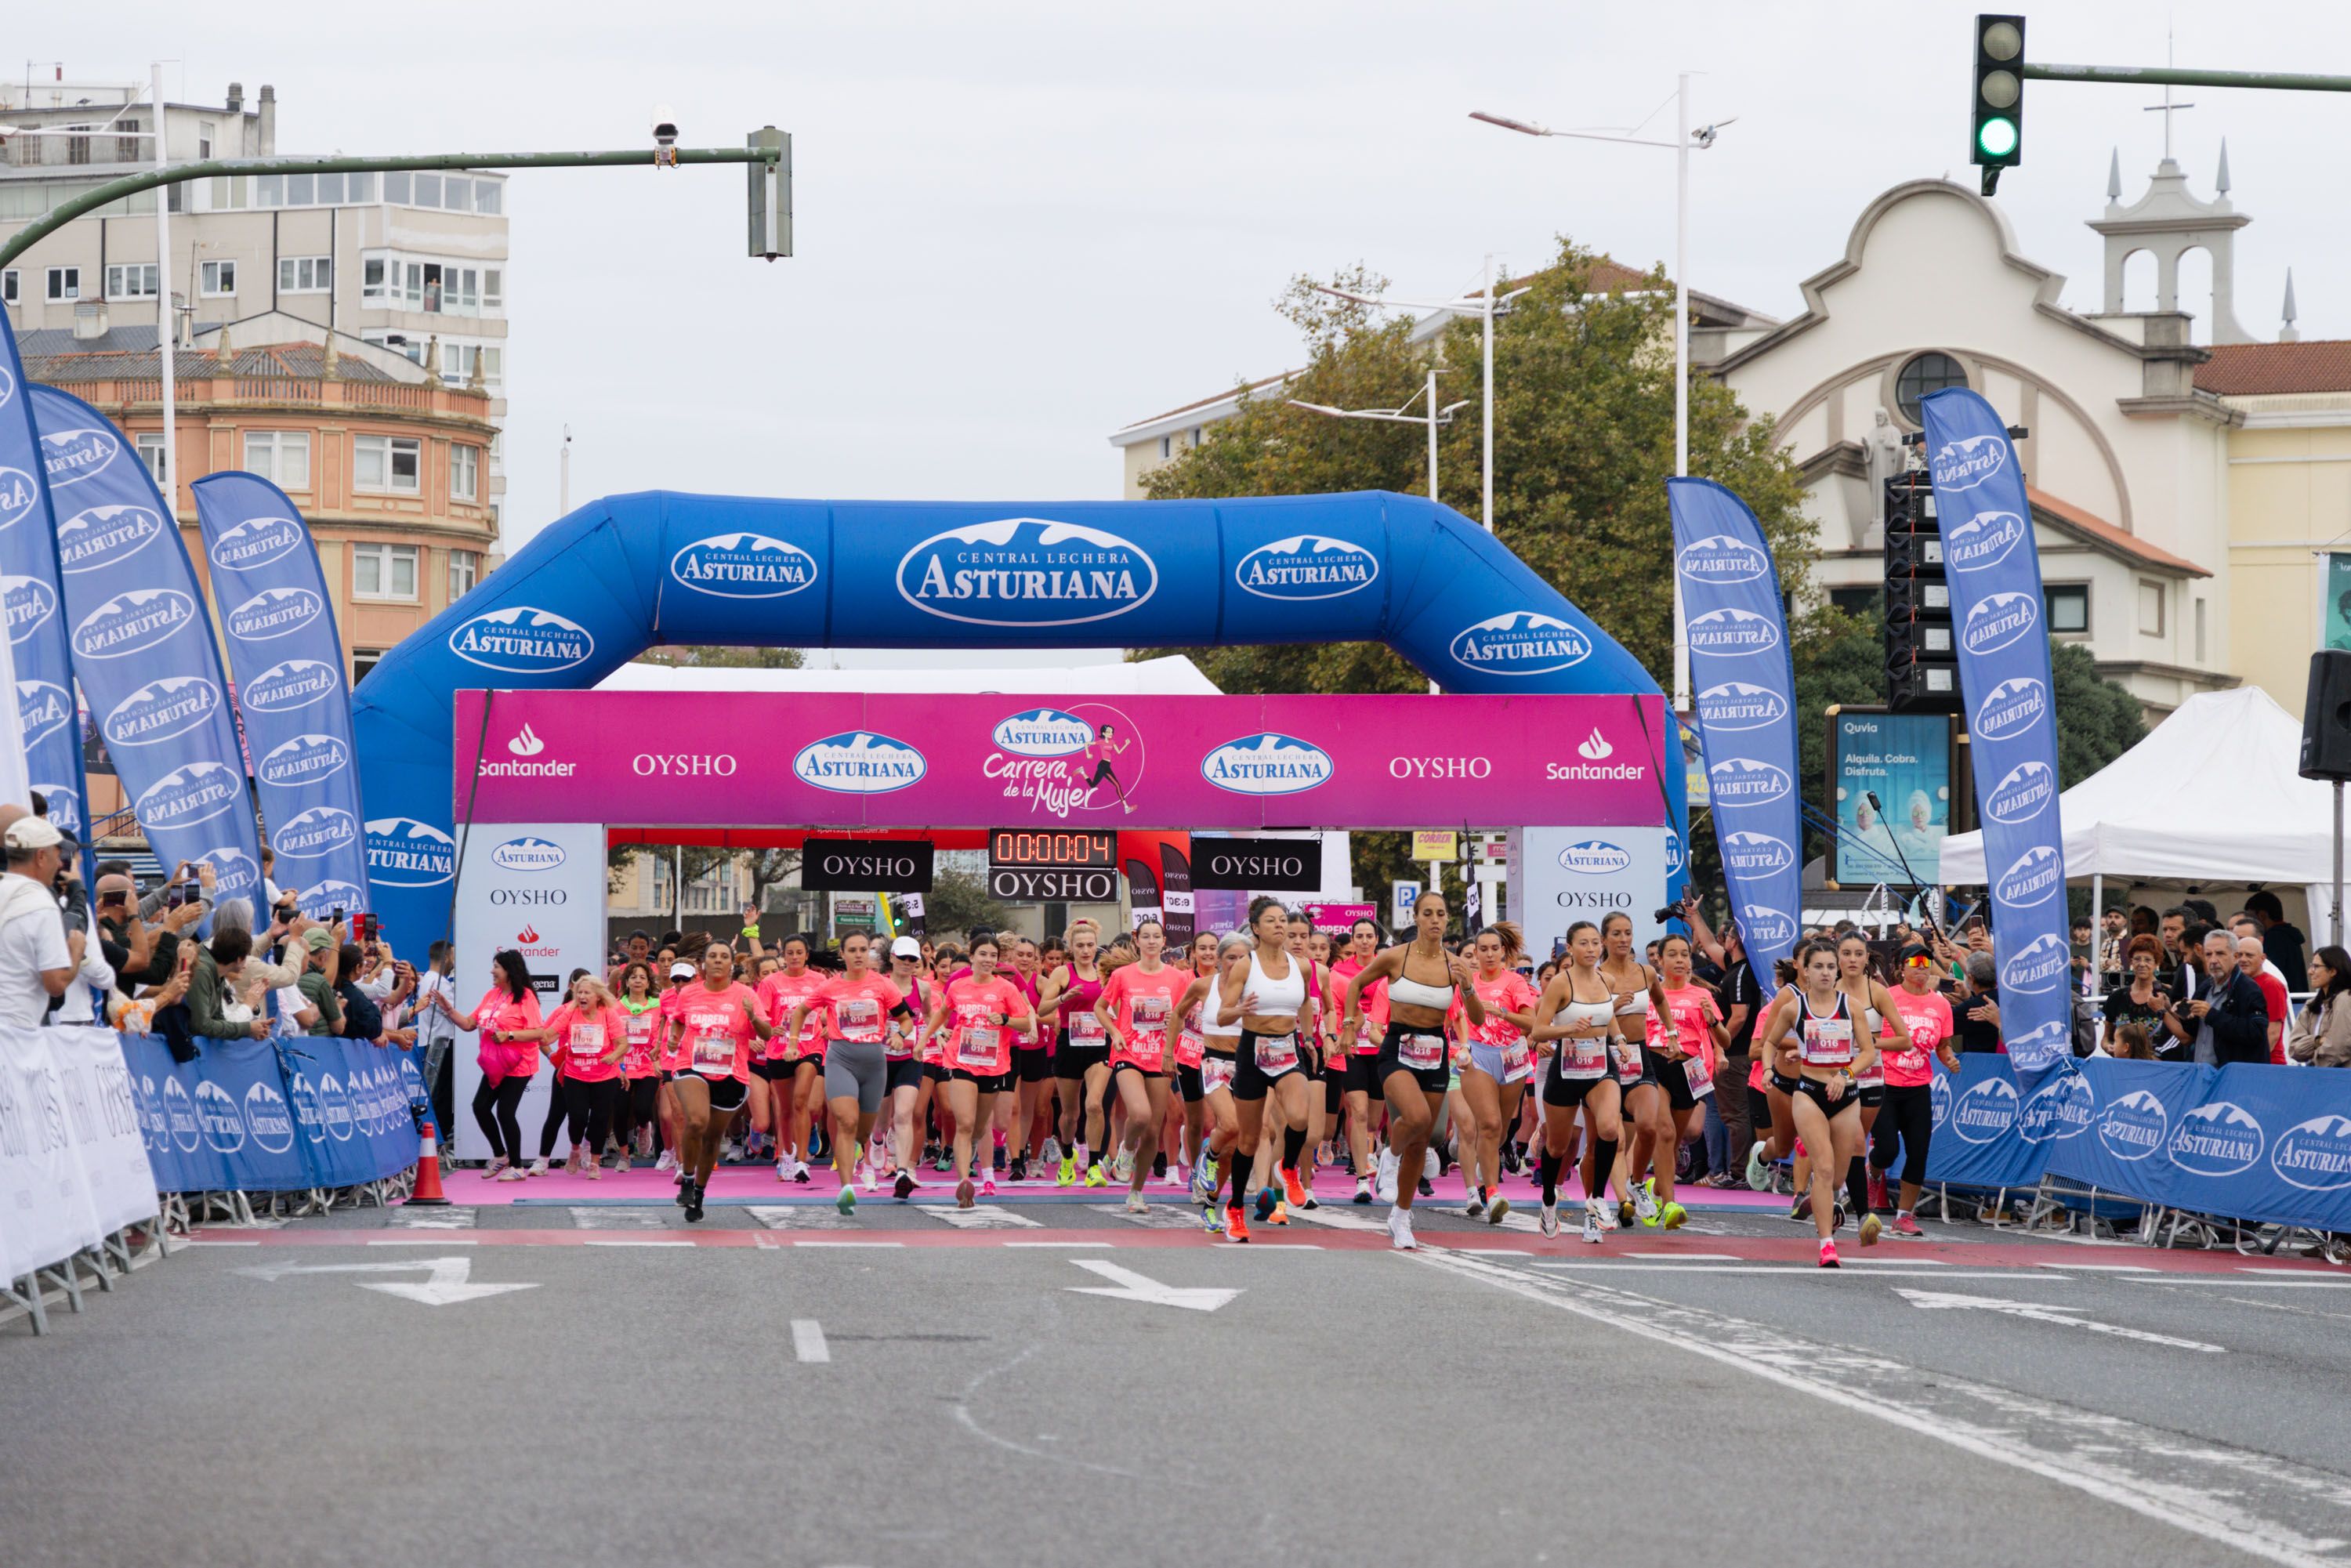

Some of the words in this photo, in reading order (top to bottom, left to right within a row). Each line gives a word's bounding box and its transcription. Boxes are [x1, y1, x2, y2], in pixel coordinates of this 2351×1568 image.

[705, 552, 752, 562] CENTRAL
[755, 554, 802, 563] LECHERA
[958, 552, 1039, 564] CENTRAL
[1047, 552, 1129, 564] LECHERA
[1268, 556, 1314, 566] CENTRAL
[1317, 556, 1364, 564] LECHERA
[682, 553, 806, 584] ASTURIANA
[915, 553, 1138, 600] ASTURIANA
[1246, 560, 1369, 586] ASTURIANA
[484, 626, 530, 636] CENTRAL
[534, 630, 581, 640] LECHERA
[1483, 633, 1529, 642] CENTRAL
[458, 628, 583, 659] ASTURIANA
[1462, 637, 1585, 661] ASTURIANA
[1001, 726, 1086, 745] ASTURIANA
[1844, 722, 1878, 734] Quvia
[477, 759, 576, 777] Santander
[633, 754, 737, 776] OYSHO
[804, 753, 917, 778] ASTURIANA
[984, 753, 1067, 778] Carrera
[1212, 755, 1323, 780] ASTURIANA
[1389, 757, 1491, 779] OYSHO
[1845, 754, 1882, 765] Alquila.
[1885, 754, 1918, 763] Cobra.
[1546, 762, 1645, 780] Santander
[1846, 767, 1889, 777] Disfruta.
[1003, 783, 1020, 798] de
[1023, 783, 1034, 798] la
[1031, 777, 1099, 817] Mujer
[368, 838, 406, 849] ENTRAL
[411, 843, 452, 853] LECHERA
[998, 834, 1108, 861] 00:00:04
[368, 849, 452, 874] TURIANA
[498, 850, 560, 863] ASTURIANA
[1211, 855, 1302, 876] OYSHO
[1564, 852, 1625, 866] ASTURIANA
[824, 856, 915, 877] OYSHO
[994, 872, 1111, 898] OYSHO
[491, 889, 567, 905] OYSHO
[1557, 892, 1632, 907] OYSHO
[532, 980, 556, 990] gena
[690, 1014, 730, 1026] CARRERA
[1901, 1015, 1934, 1029] ARRERA
[1132, 1042, 1160, 1053] MUJER
[1512, 1057, 1524, 1066] 016
[1698, 1073, 1708, 1081] 01
[1956, 1099, 2012, 1129] ASTURIANA
[2102, 1116, 2159, 1148] ASTURIANA
[2195, 1124, 2222, 1135] ENTRAL
[2225, 1129, 2257, 1139] LECHERA
[2172, 1124, 2254, 1163] ASTURIANA
[2298, 1138, 2328, 1149] CENTRAL
[2277, 1138, 2351, 1174] ASTURIAN
